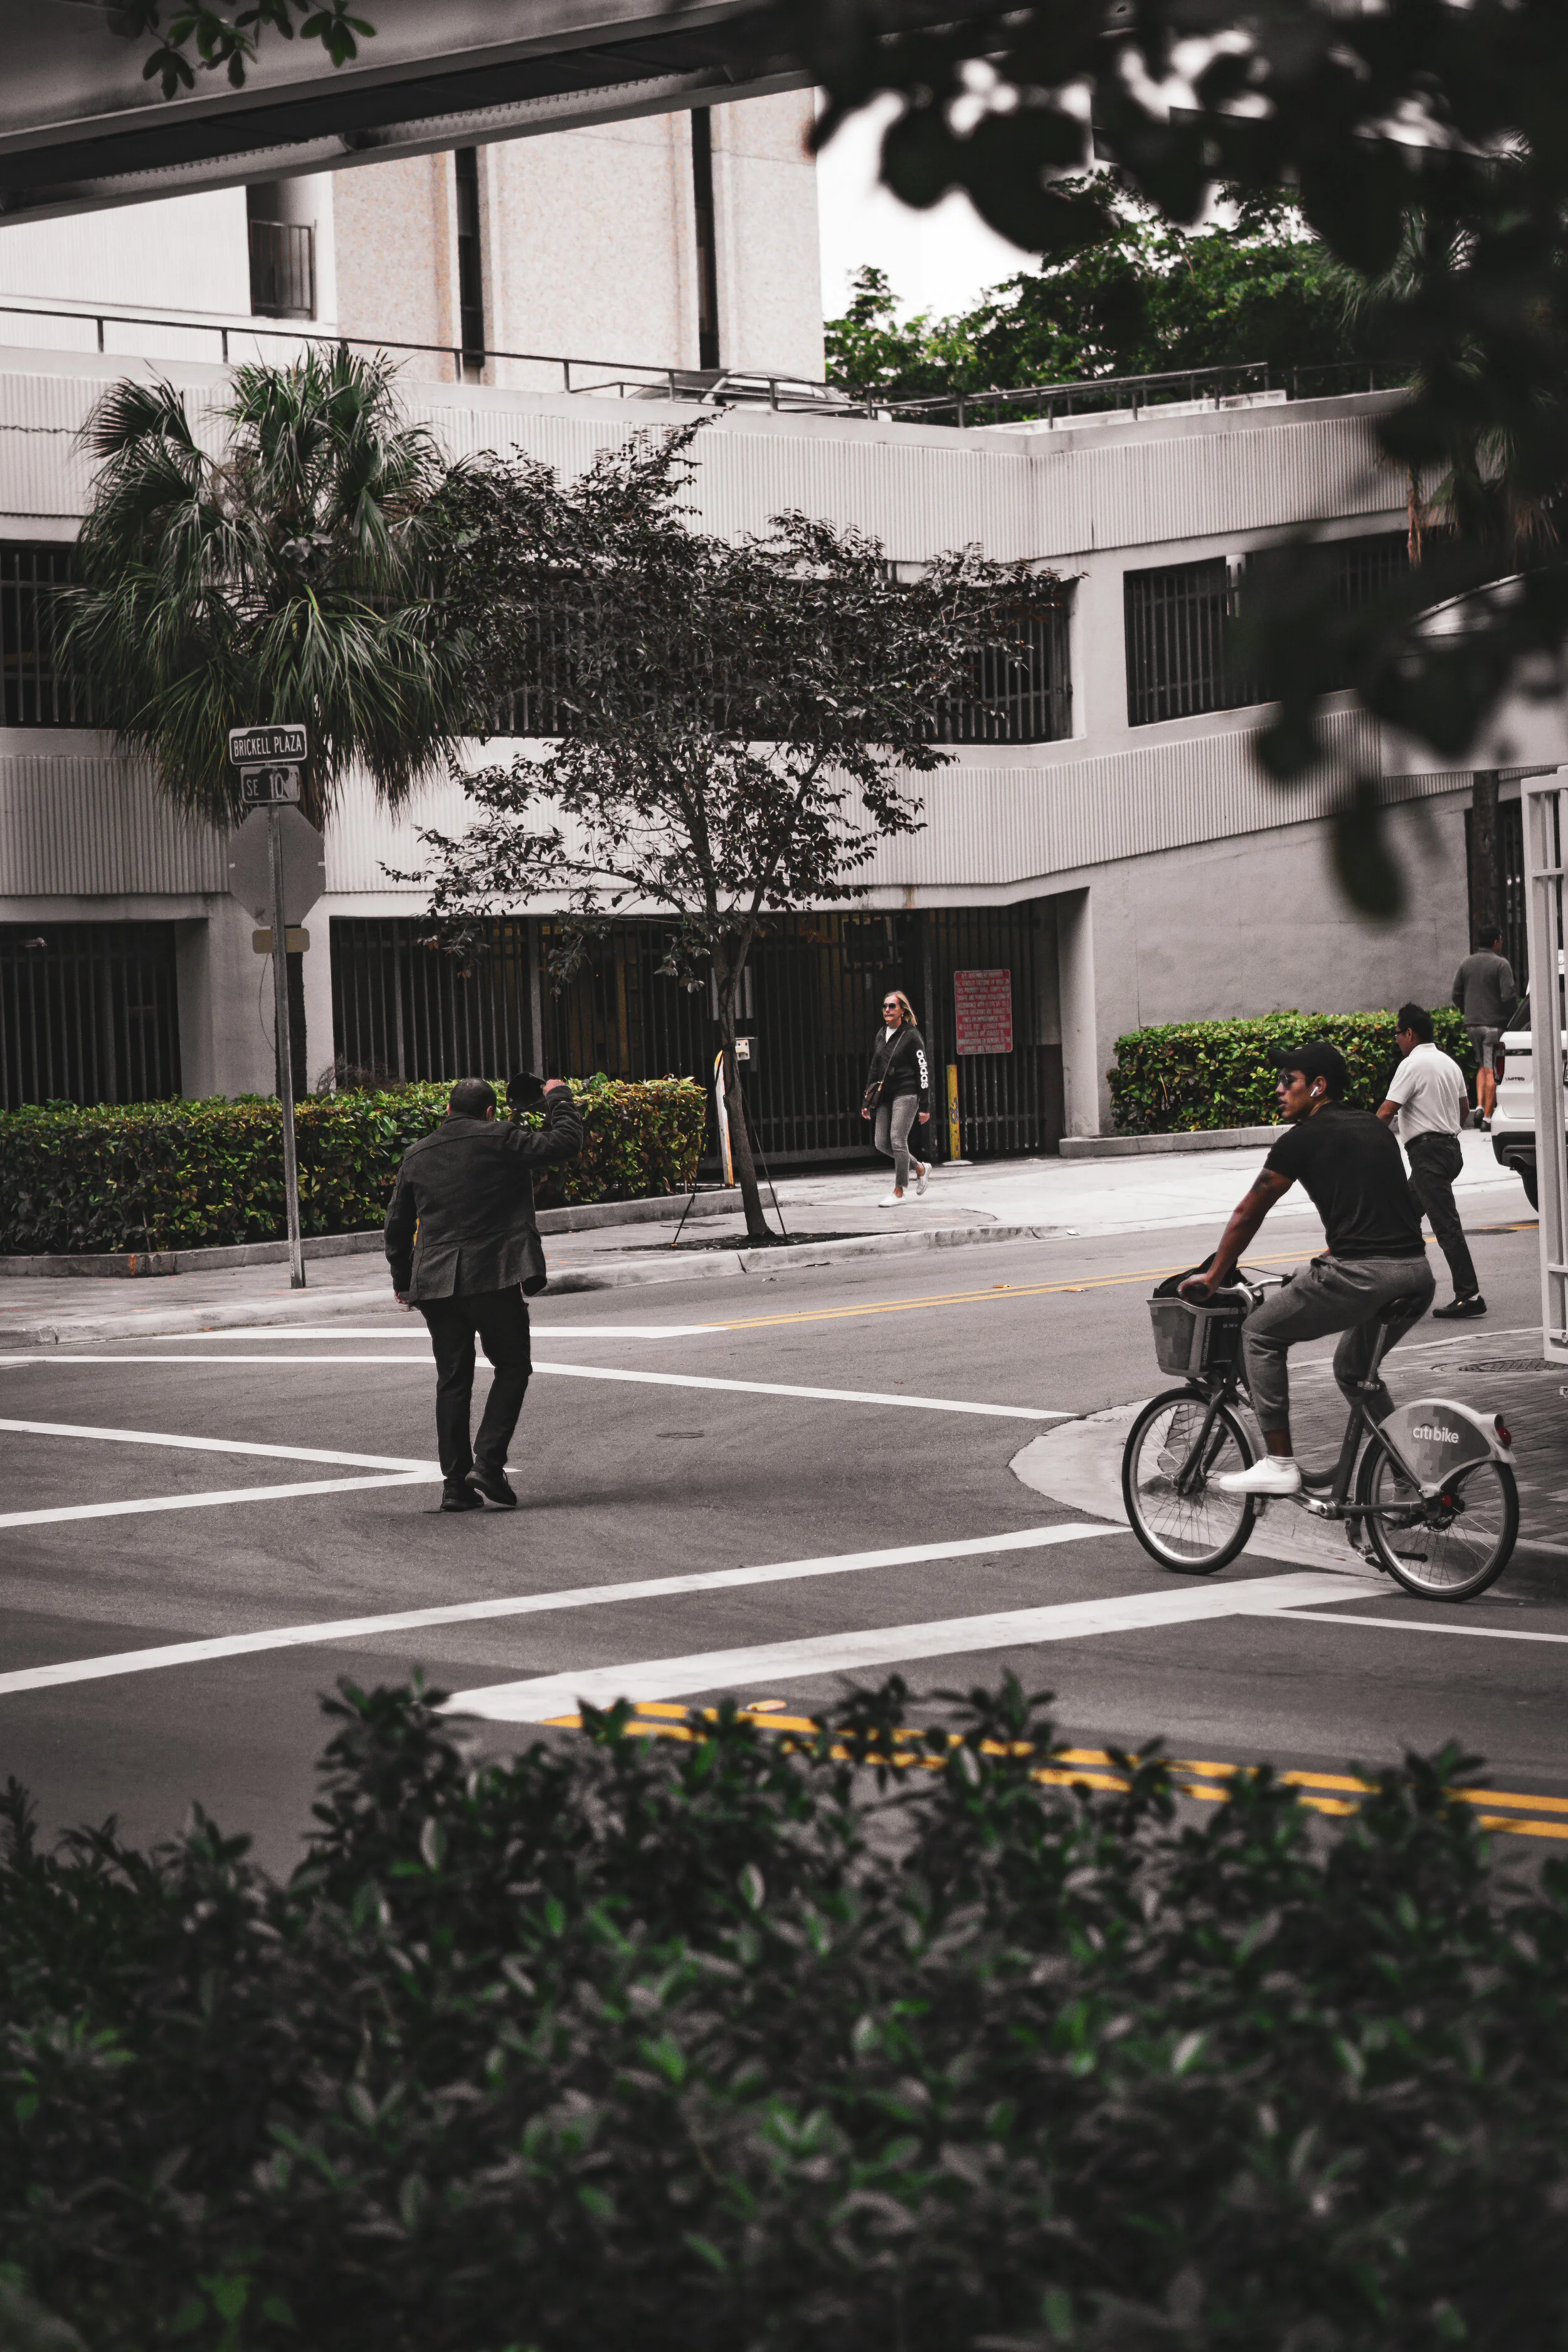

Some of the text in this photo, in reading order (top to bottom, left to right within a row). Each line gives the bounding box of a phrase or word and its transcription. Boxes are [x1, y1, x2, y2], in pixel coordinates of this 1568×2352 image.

[234, 734, 302, 757] BRICKELL PLAZA
[246, 779, 259, 797] SE
[916, 1049, 928, 1089] adidas
